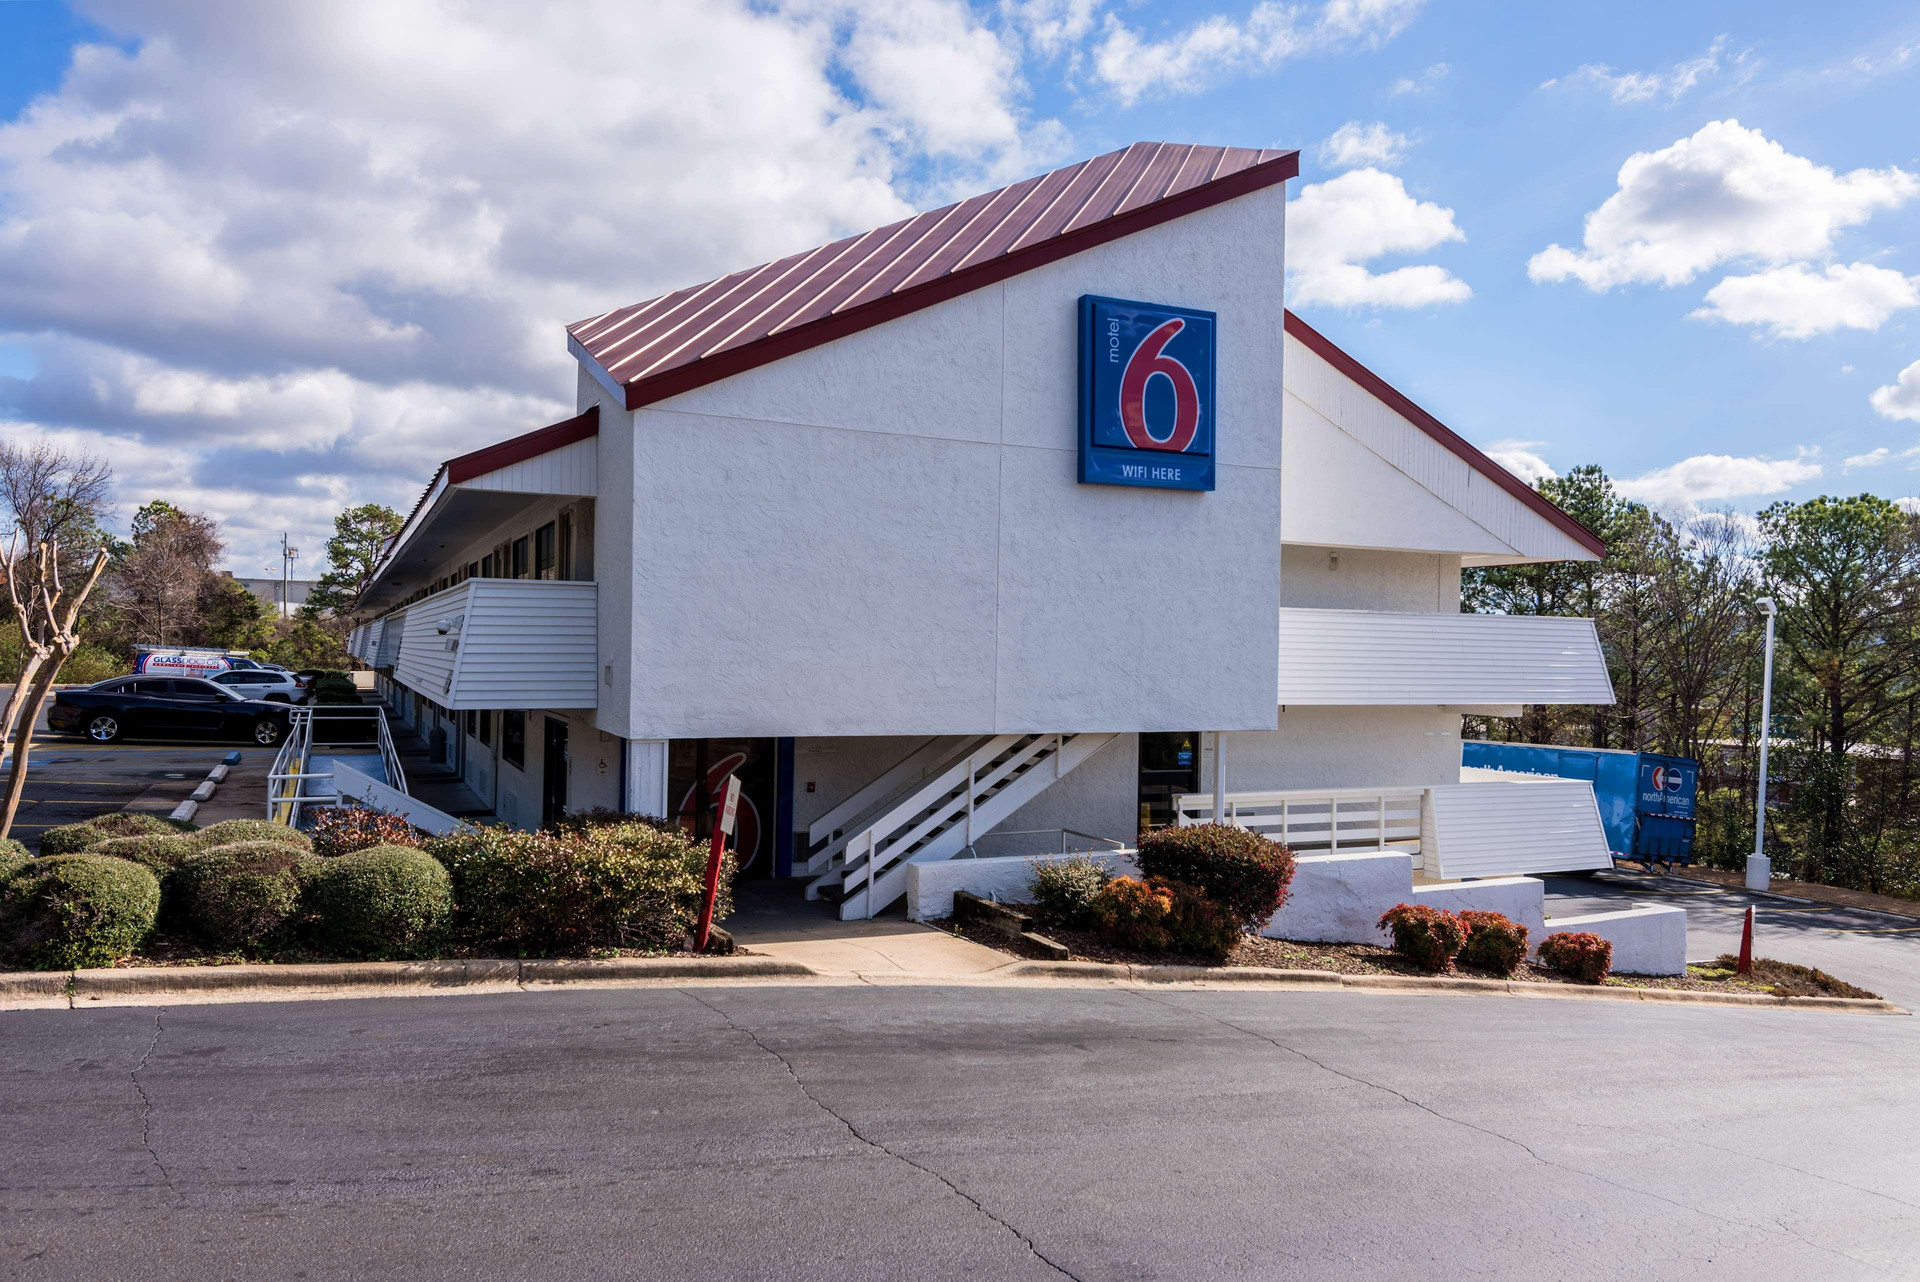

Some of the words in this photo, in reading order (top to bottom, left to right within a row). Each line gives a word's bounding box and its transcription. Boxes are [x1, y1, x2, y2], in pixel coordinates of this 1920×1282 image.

[1107, 318, 1120, 363] motel
[1118, 317, 1200, 453] 6
[1122, 464, 1147, 479] WIFI
[1152, 467, 1181, 481] HERE
